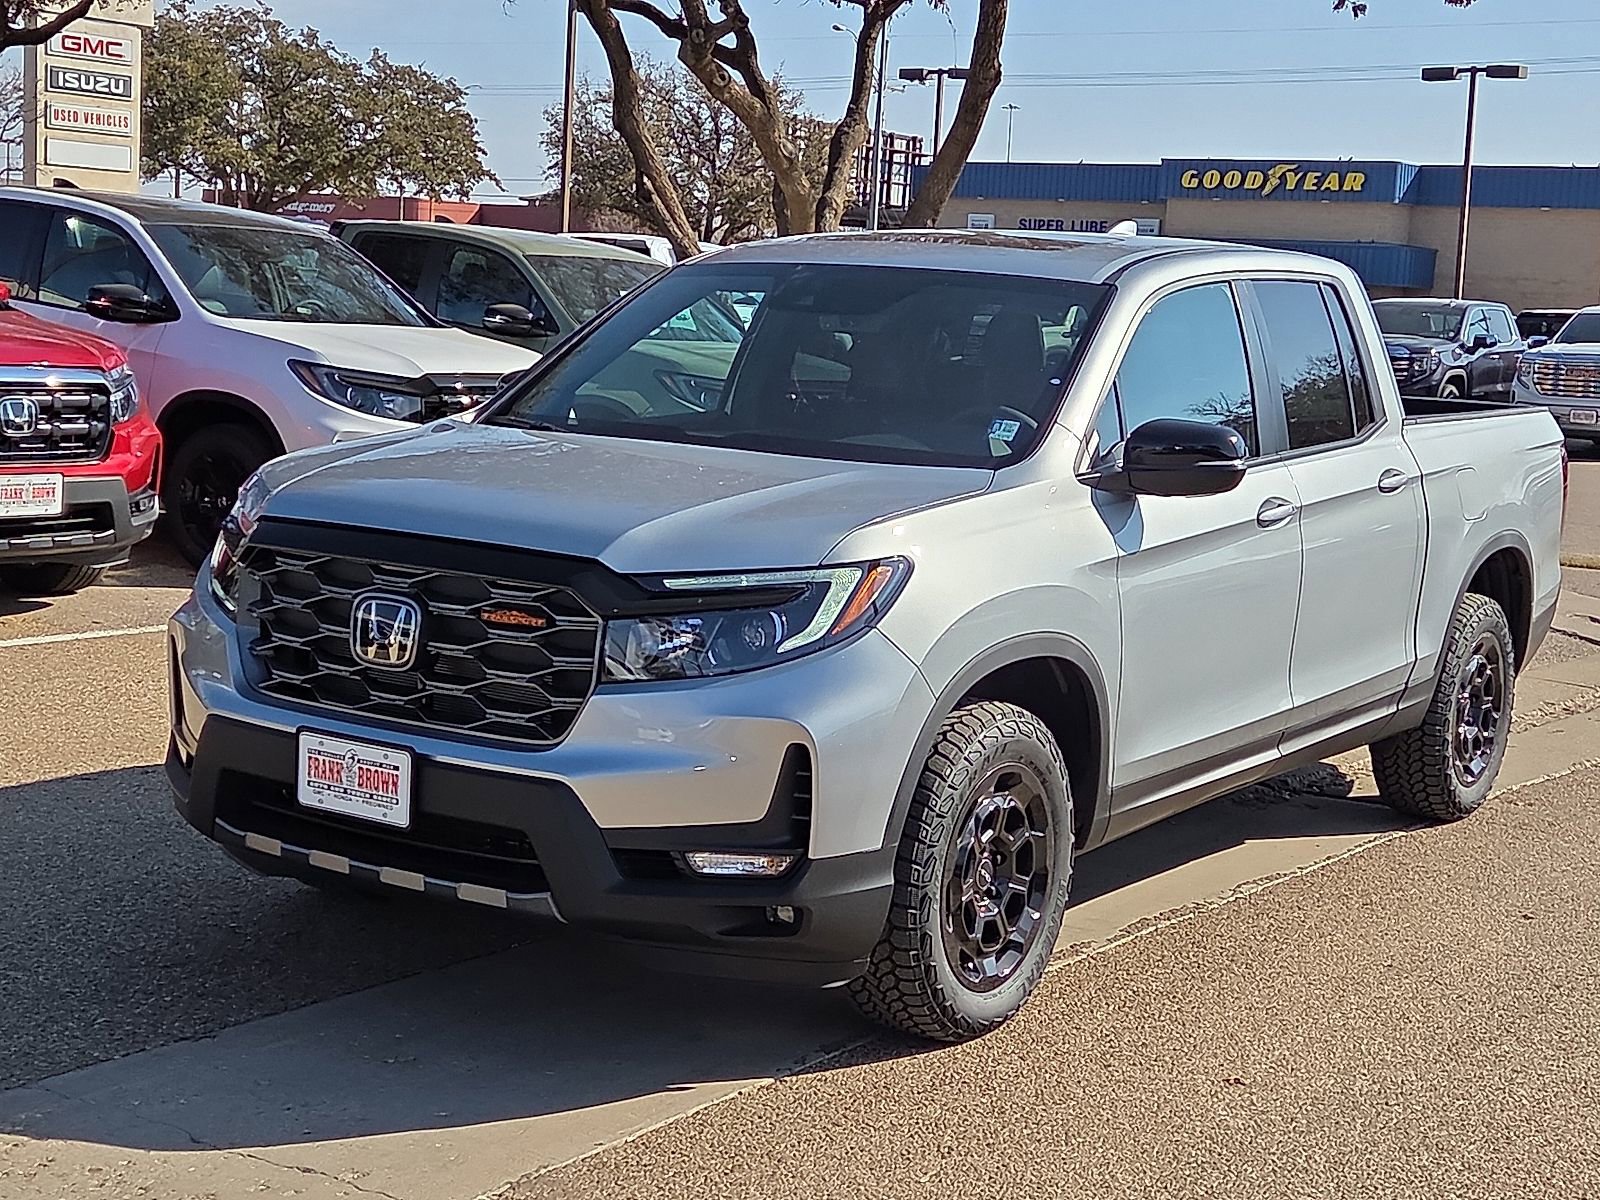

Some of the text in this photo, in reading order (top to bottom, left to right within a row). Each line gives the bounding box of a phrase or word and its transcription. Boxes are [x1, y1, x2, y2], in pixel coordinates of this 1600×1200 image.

[62, 35, 123, 58] GMC
[58, 71, 124, 94] ISUZU
[53, 108, 129, 128] USED VEHICLES
[1018, 217, 1109, 233] SUPER LUBE
[307, 755, 344, 785] FRANK
[357, 765, 400, 796] BROWN
